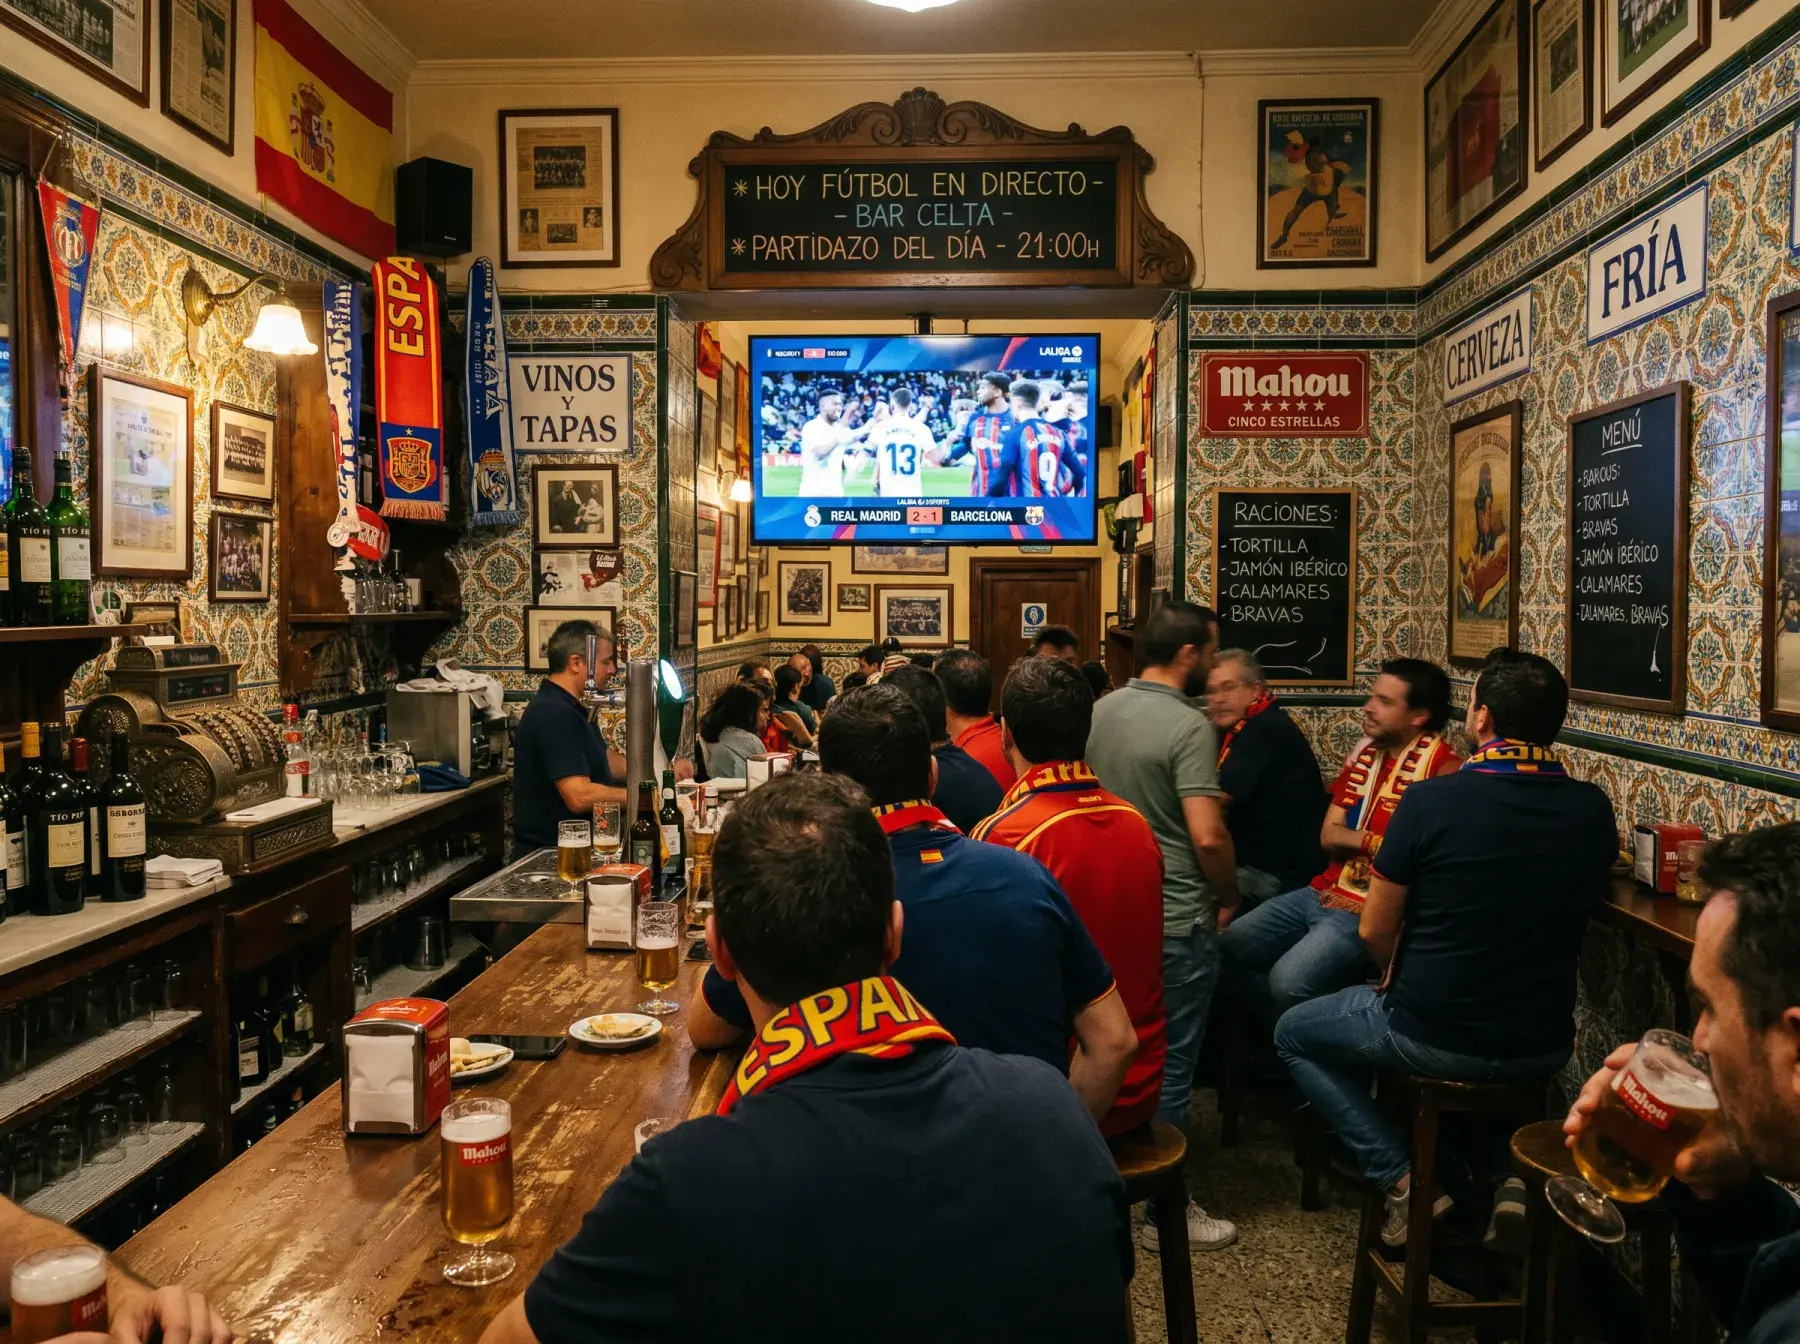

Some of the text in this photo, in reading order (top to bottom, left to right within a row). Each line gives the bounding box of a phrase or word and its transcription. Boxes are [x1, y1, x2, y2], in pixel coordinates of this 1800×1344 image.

[756, 168, 1087, 200] HOY FÚTBOL EN DIRECTO
[856, 202, 995, 228] BAR CELTA
[752, 232, 879, 261] PARTIDAZO
[893, 236, 935, 260] DEL
[947, 229, 987, 259] DÍA
[1602, 218, 1687, 319] FRÍA
[1039, 346, 1071, 357] LALIGA
[1447, 308, 1524, 391] CERVEZA
[521, 364, 616, 393] VINOS
[1217, 364, 1352, 397] Mahou
[561, 396, 574, 411] Y
[520, 415, 617, 443] TAPAS
[1228, 416, 1341, 428] CINCO ESTRELLAS
[1602, 407, 1641, 449] MENÚ
[886, 442, 917, 476] 13
[830, 510, 858, 522] REAL
[859, 510, 901, 522] MADRID
[950, 510, 1013, 522] BARCELONA
[1234, 501, 1339, 523] RACIONES:
[1290, 556, 1348, 577] IBÉRICO
[1631, 603, 1669, 627] BRAVAS
[1622, 1074, 1669, 1122] Mahou
[462, 1141, 507, 1161] Mahou
